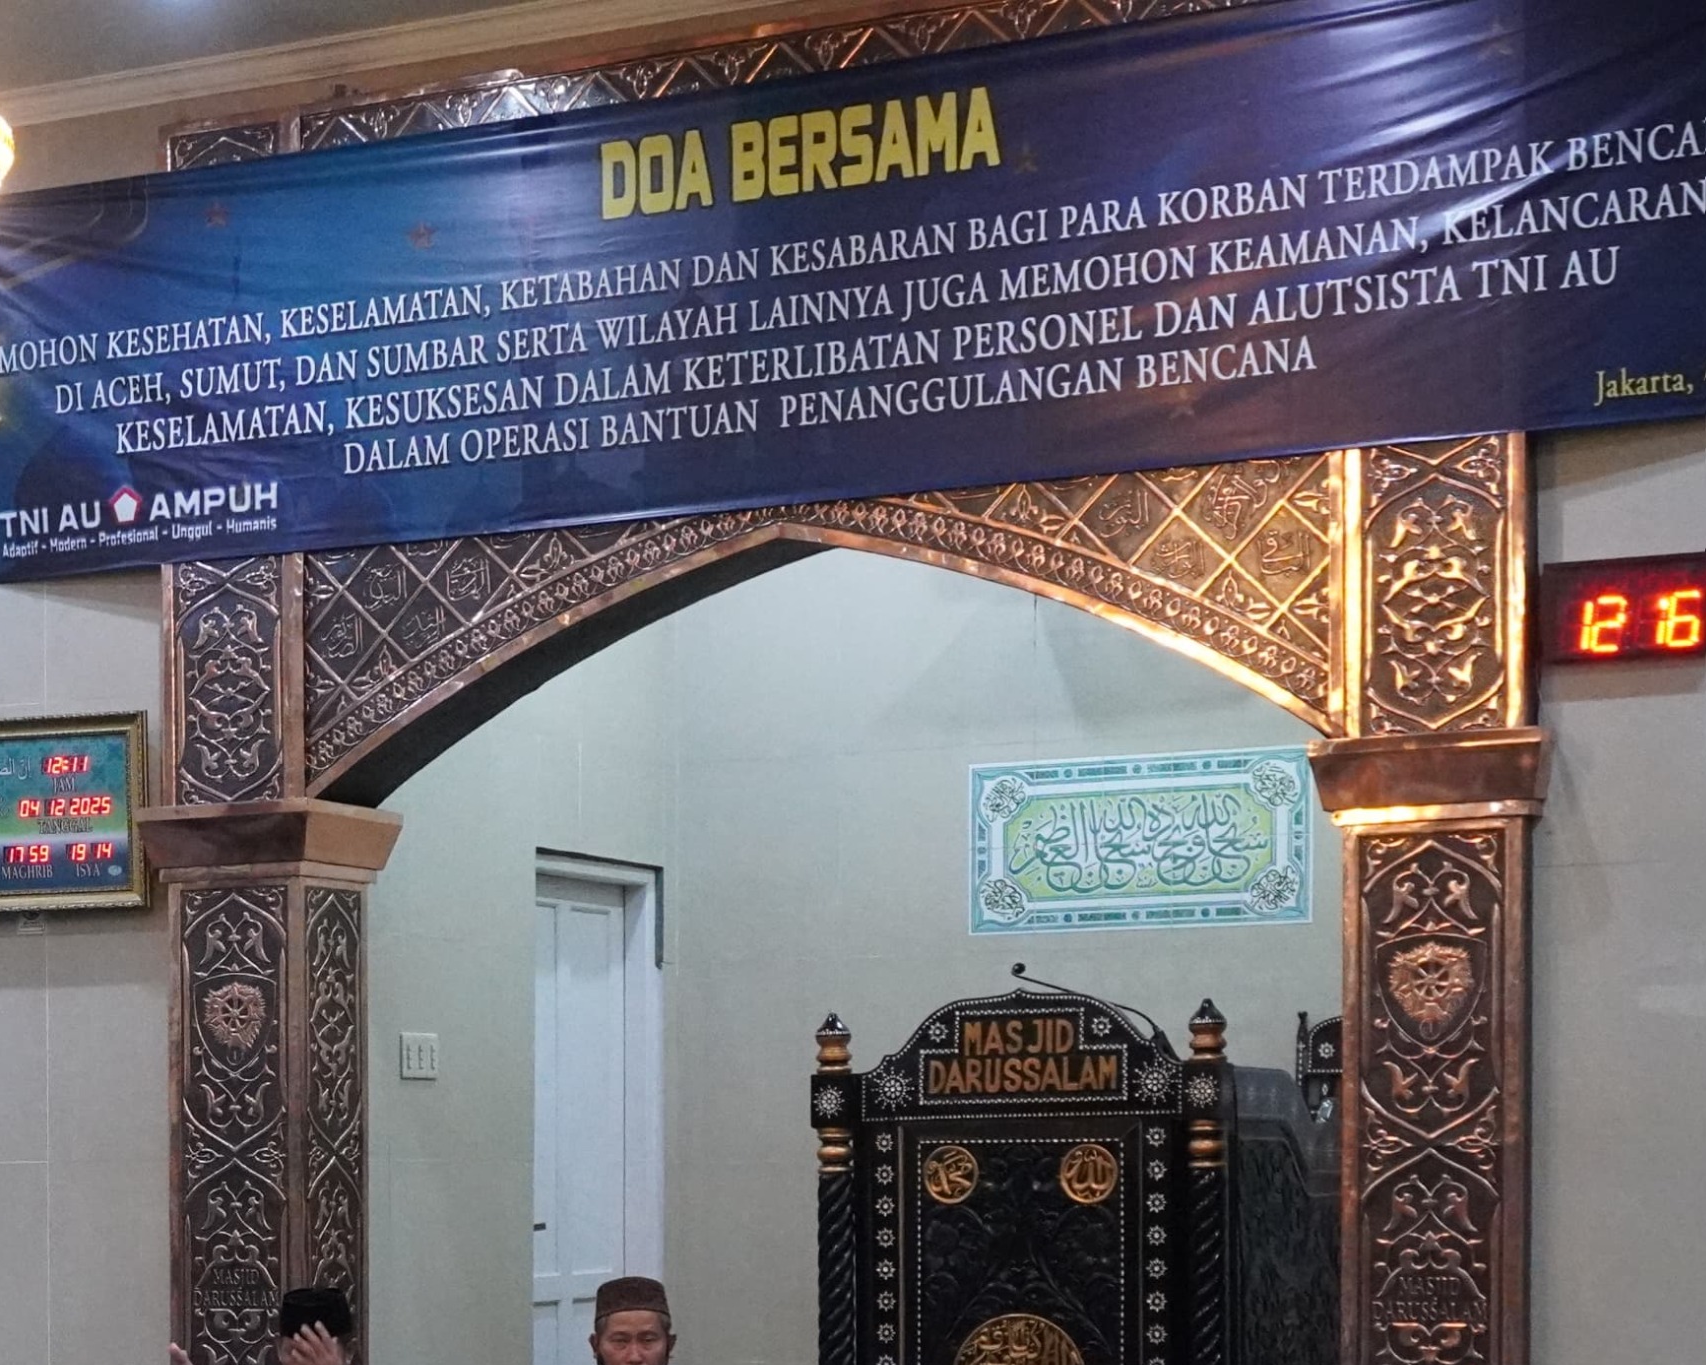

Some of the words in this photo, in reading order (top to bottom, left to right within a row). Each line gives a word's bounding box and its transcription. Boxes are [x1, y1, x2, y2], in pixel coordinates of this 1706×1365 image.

[600, 128, 714, 221] DOA
[731, 86, 1002, 204] BERSAMA
[105, 311, 272, 360] KESEHATAN,
[280, 283, 491, 339] KESELAMATAN,
[500, 258, 682, 311] KETABAHAN
[691, 247, 760, 287] DAN
[769, 221, 957, 277] KESABARAN
[967, 208, 1048, 251] BAGI
[1059, 195, 1148, 239] PARA
[1157, 173, 1308, 227] KORBAN
[1317, 141, 1554, 205] TERDAMPAK
[1567, 118, 1706, 172] BENCA
[55, 381, 85, 414] DI
[90, 371, 171, 410] ACEH,
[179, 356, 286, 399] SUMUT,
[295, 348, 358, 386] DAN
[366, 334, 490, 378] SUMBAR
[496, 321, 589, 363] SERTA
[595, 302, 738, 350] WILAYAH
[748, 283, 894, 332] LAINNYA
[900, 271, 990, 323] JUGA
[998, 244, 1197, 302] MEMOHON
[1207, 216, 1428, 276] KEAMANAN,
[1442, 176, 1706, 246] KELANCARAN
[115, 399, 334, 455] KESELAMATAN,
[344, 375, 545, 429] KESUKSESAN
[554, 360, 672, 407] DALAM
[682, 328, 942, 392] KETERLIBATAN
[952, 305, 1143, 361] PERSONEL
[1153, 292, 1238, 338] DAN
[1246, 265, 1463, 327] ALUTSISTA
[1470, 254, 1548, 299] TNI
[1559, 245, 1621, 289] AU
[343, 431, 451, 475] DALAM
[460, 416, 590, 462] OPERASI
[600, 398, 760, 448] BANTUAN
[779, 356, 1124, 428] PENANGGULANGAN
[1135, 335, 1318, 389] BENCANA
[1593, 366, 1694, 407] Jakarta,
[58, 500, 102, 532] AU
[148, 481, 279, 522] AMPUH
[1, 541, 39, 559] Adaptif
[49, 537, 87, 553] Modern
[98, 529, 159, 548] Profesional
[171, 521, 213, 542] Unggul
[225, 516, 278, 534] Humanis
[46, 755, 88, 774] 12:11
[52, 777, 78, 794] JAM
[19, 799, 40, 818] 04
[49, 798, 66, 816] 12
[69, 796, 112, 815] 2025
[37, 817, 94, 835] TANGGAL
[1, 864, 54, 881] MAGHRIB
[963, 1018, 1075, 1057] MASJID
[927, 1054, 1118, 1095] DARUSSALAM
[212, 1267, 260, 1286] MASJID
[1398, 1276, 1461, 1295] MASJID
[193, 1289, 281, 1308] DARUSSALAM
[1372, 1300, 1487, 1320] DARUSSALAM
